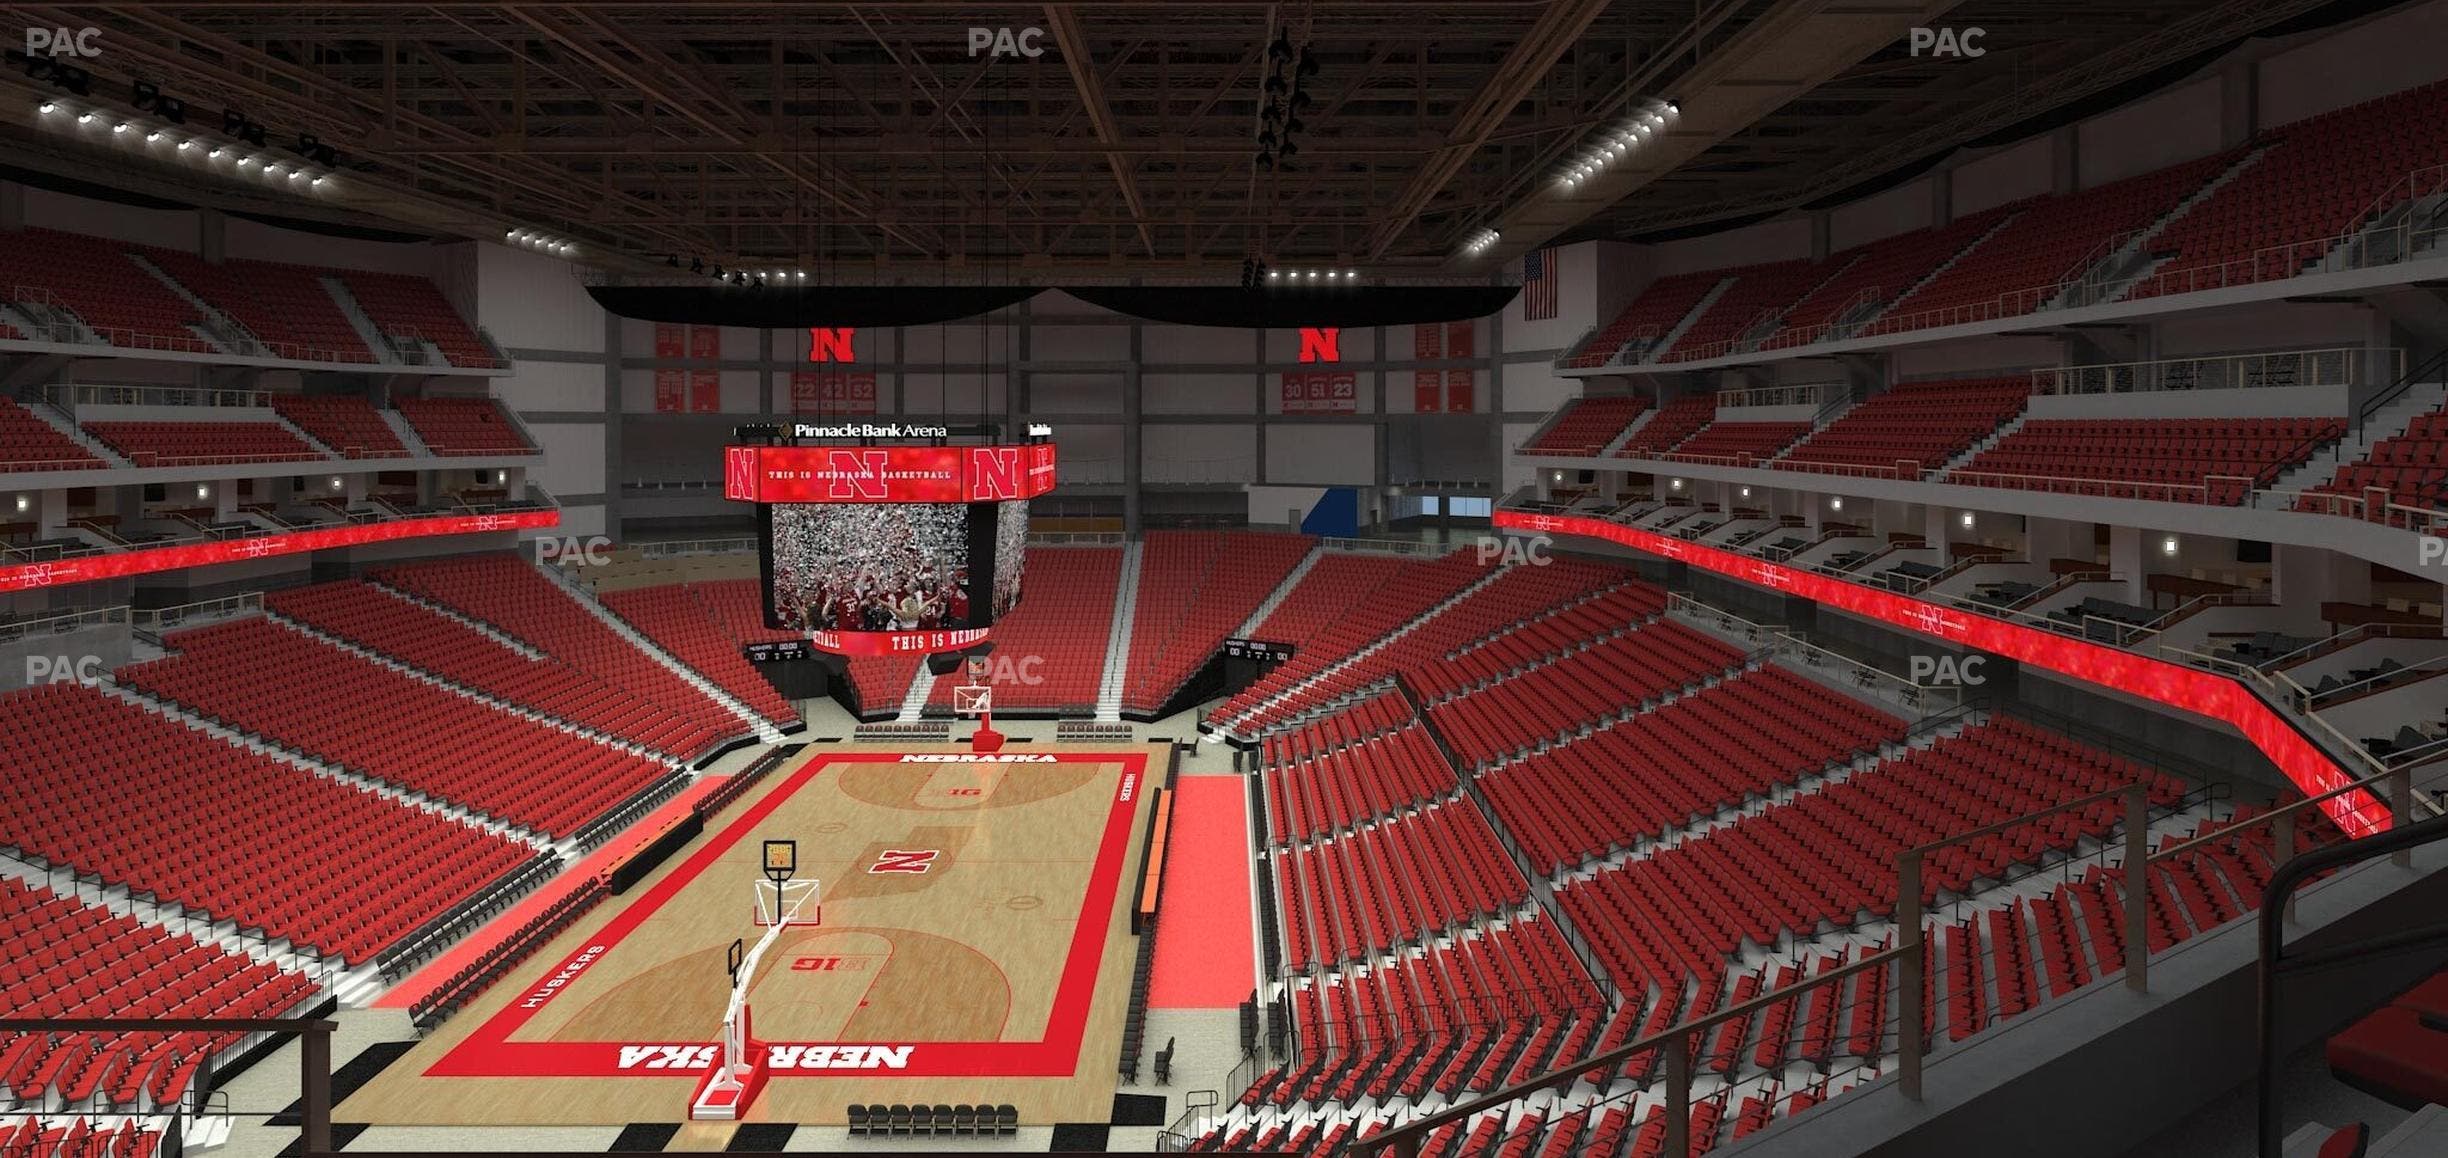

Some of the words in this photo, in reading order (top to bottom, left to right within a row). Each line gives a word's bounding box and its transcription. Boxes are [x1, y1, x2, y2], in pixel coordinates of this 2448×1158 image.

[808, 327, 855, 362] N
[1298, 327, 1339, 362] N
[853, 383, 873, 398] 52
[1285, 383, 1300, 398] 30
[1334, 382, 1352, 396] 23
[795, 423, 861, 437] Pinnacle
[862, 423, 901, 437] Bank
[903, 424, 947, 437] Arena
[730, 449, 753, 499] N
[768, 471, 794, 479] THIS
[829, 451, 888, 498] N
[974, 449, 1017, 498] N
[892, 636, 924, 650] THIS
[931, 633, 944, 647] IS
[899, 754, 1058, 763] NEBRASKA
[520, 945, 606, 1008] HUSKERS
[617, 1045, 915, 1069] NEBRSKA
